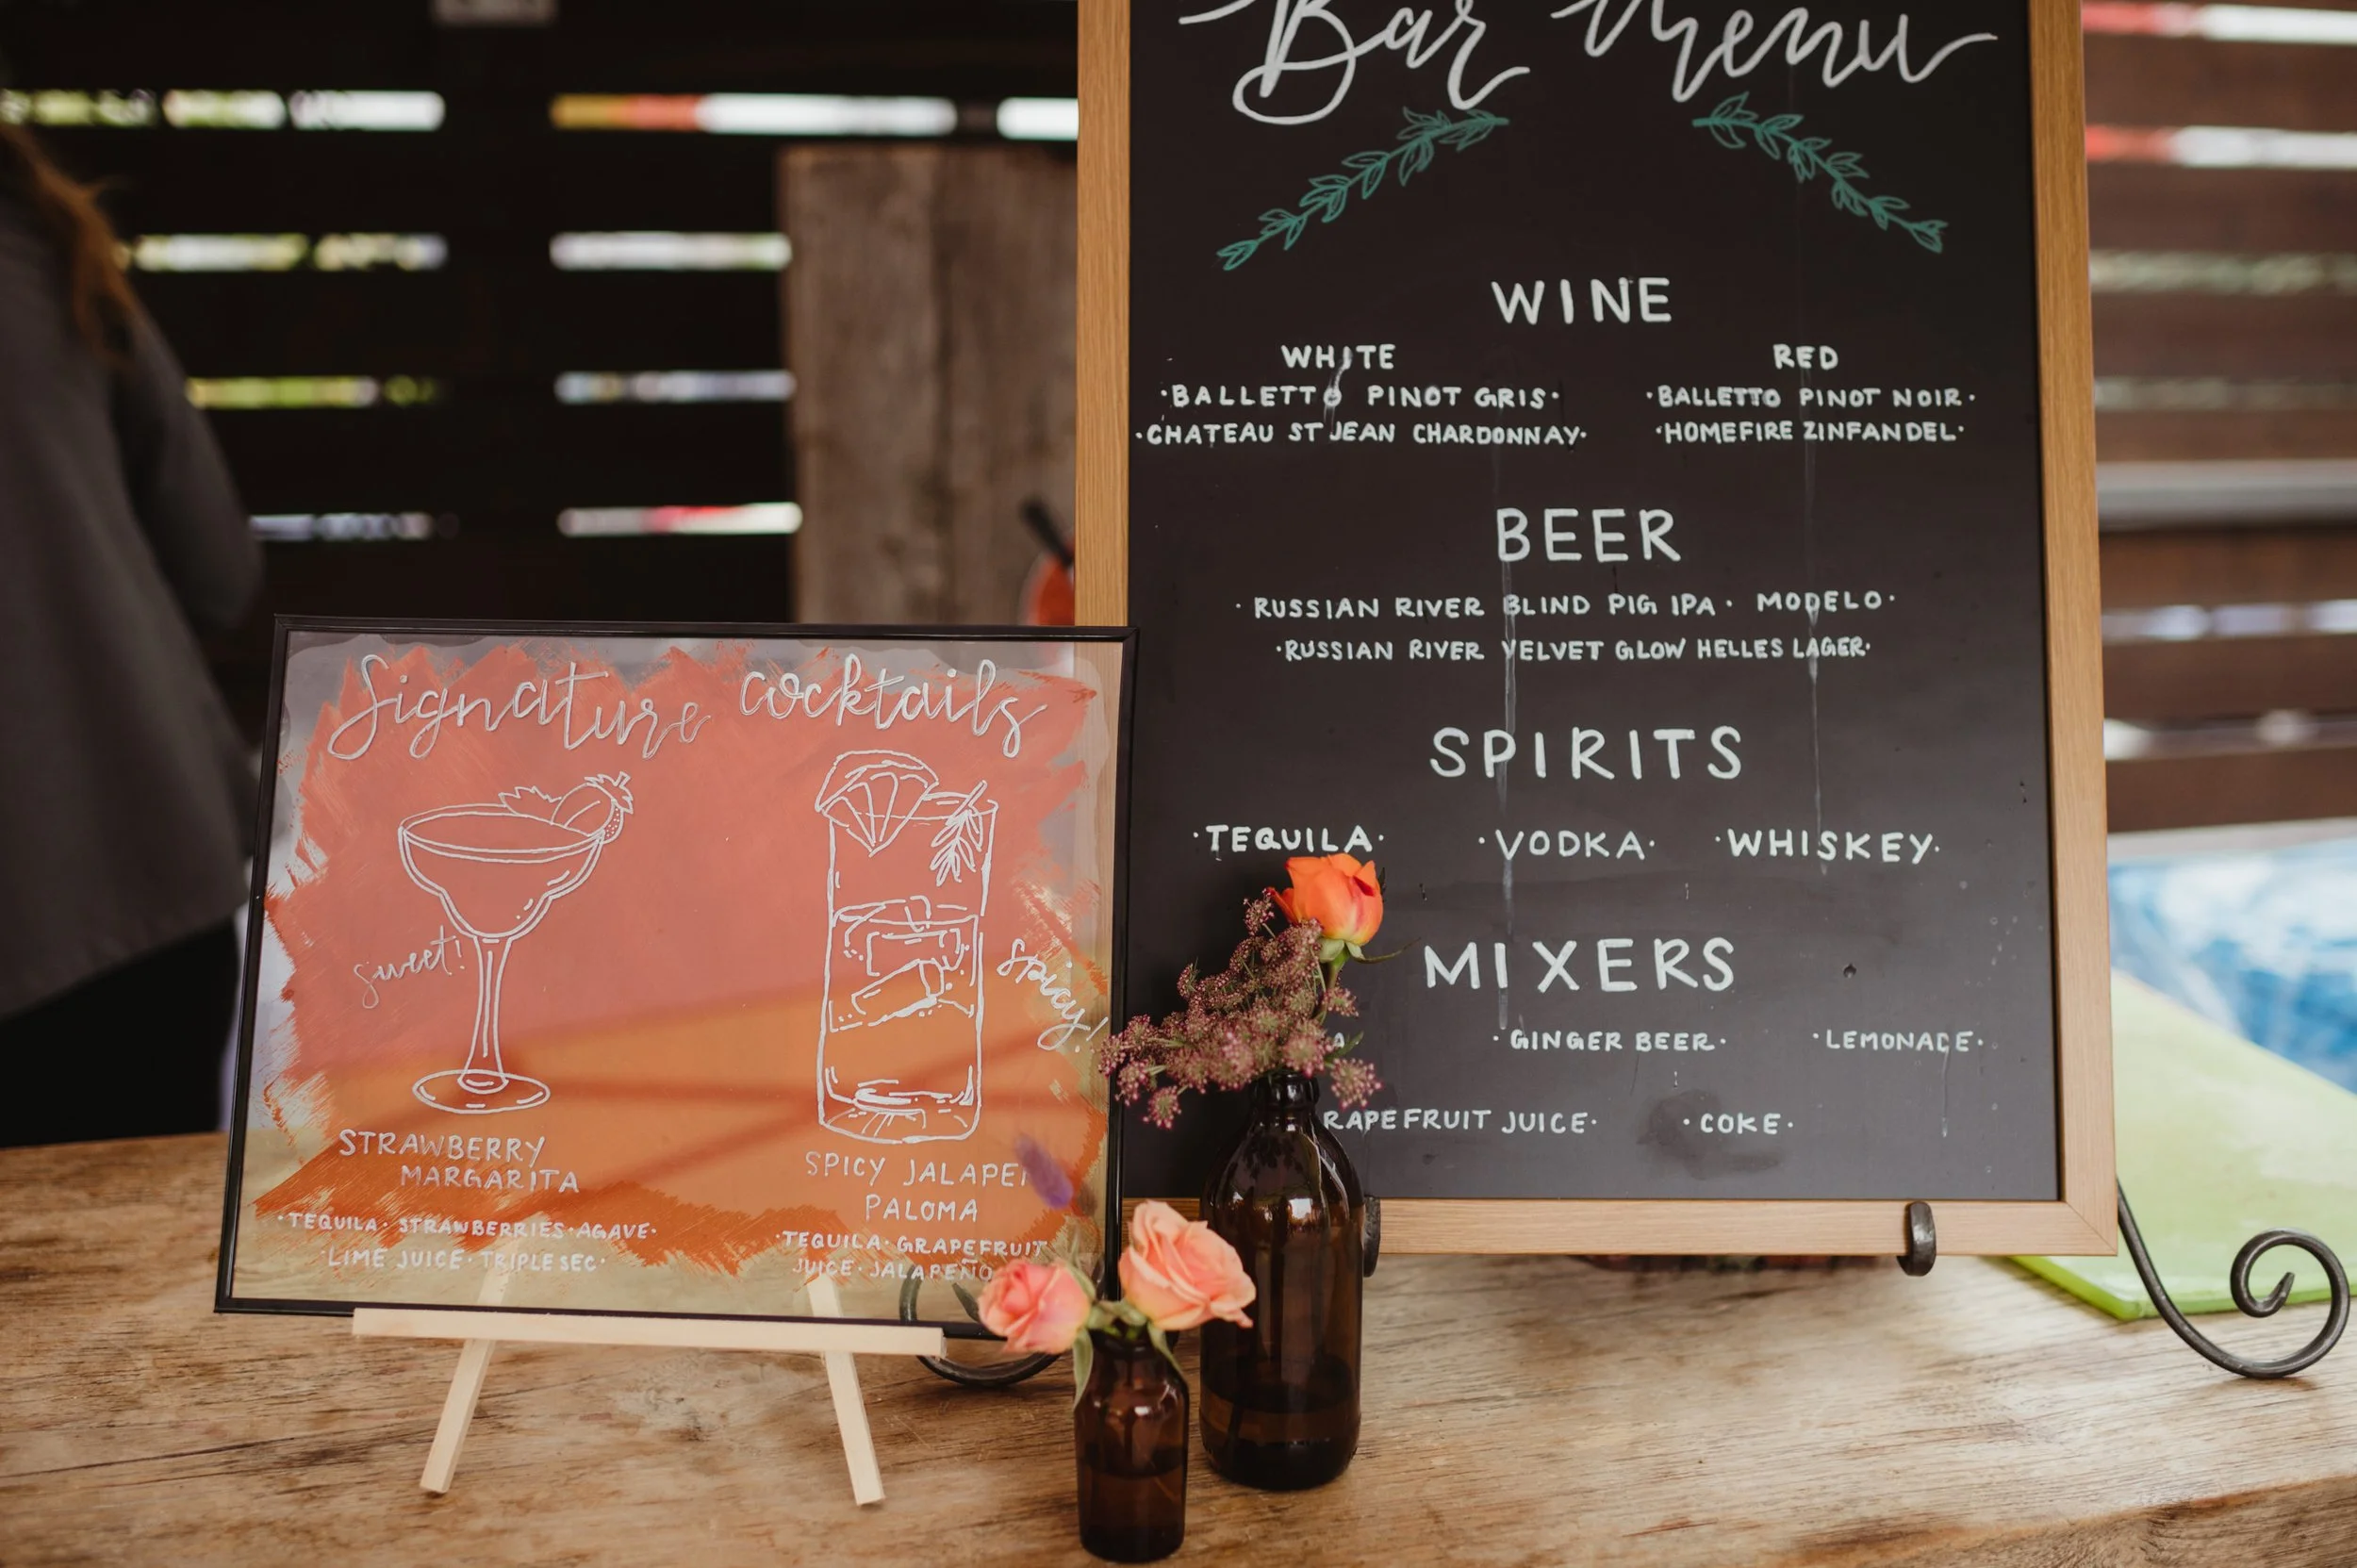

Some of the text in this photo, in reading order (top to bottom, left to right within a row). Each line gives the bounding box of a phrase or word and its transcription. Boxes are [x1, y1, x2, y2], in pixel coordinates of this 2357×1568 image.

[1492, 276, 1672, 324] WINE
[1280, 343, 1396, 370] WHITE
[1772, 343, 1838, 371] RED
[1172, 384, 1547, 409] BALLETTO PINOT GRIS
[1657, 385, 1963, 408] BALLETTO PINOT NOIR
[1146, 421, 1583, 446] CHATEAU ST JEAN CHARDONNAY
[1664, 421, 1957, 444] HOMEFIRE ZINFANDEL
[1496, 507, 1682, 563] BEER
[1254, 593, 1716, 619] RUSSIAN RIVER BLIND PIG IPA
[1756, 589, 1882, 613] MODELO
[1284, 635, 1866, 662] RUSSIAN RIVER VELVET GLOW HELLES LAGER
[326, 652, 1049, 761] Signature cocktails
[1428, 725, 1742, 780] SPIRITS
[1205, 823, 1374, 853] TEQUILA
[1494, 830, 1645, 861] VODKA
[1726, 828, 1934, 865] WHISKEY
[1424, 937, 1735, 994] MIXERS
[1510, 1030, 1716, 1052] GINGER BEER
[1323, 1107, 1588, 1134] RAPEFRUIT JUICE
[1700, 1112, 1782, 1135] COKE
[338, 1128, 546, 1169] STRAWBERRY
[400, 1164, 581, 1194] MARGARITA
[804, 1149, 1029, 1188] SPICY JALAPE
[864, 1192, 979, 1223] PALOMA
[288, 1211, 651, 1241] TEQUILA STRAWBERRIES AGAVE
[328, 1243, 389, 1267] LIME
[396, 1246, 466, 1270] JUICE
[479, 1249, 554, 1272] TRIPLE
[782, 1229, 1048, 1258] TEQUILA GRAPEFRUIT
[791, 1257, 855, 1276] JUICE
